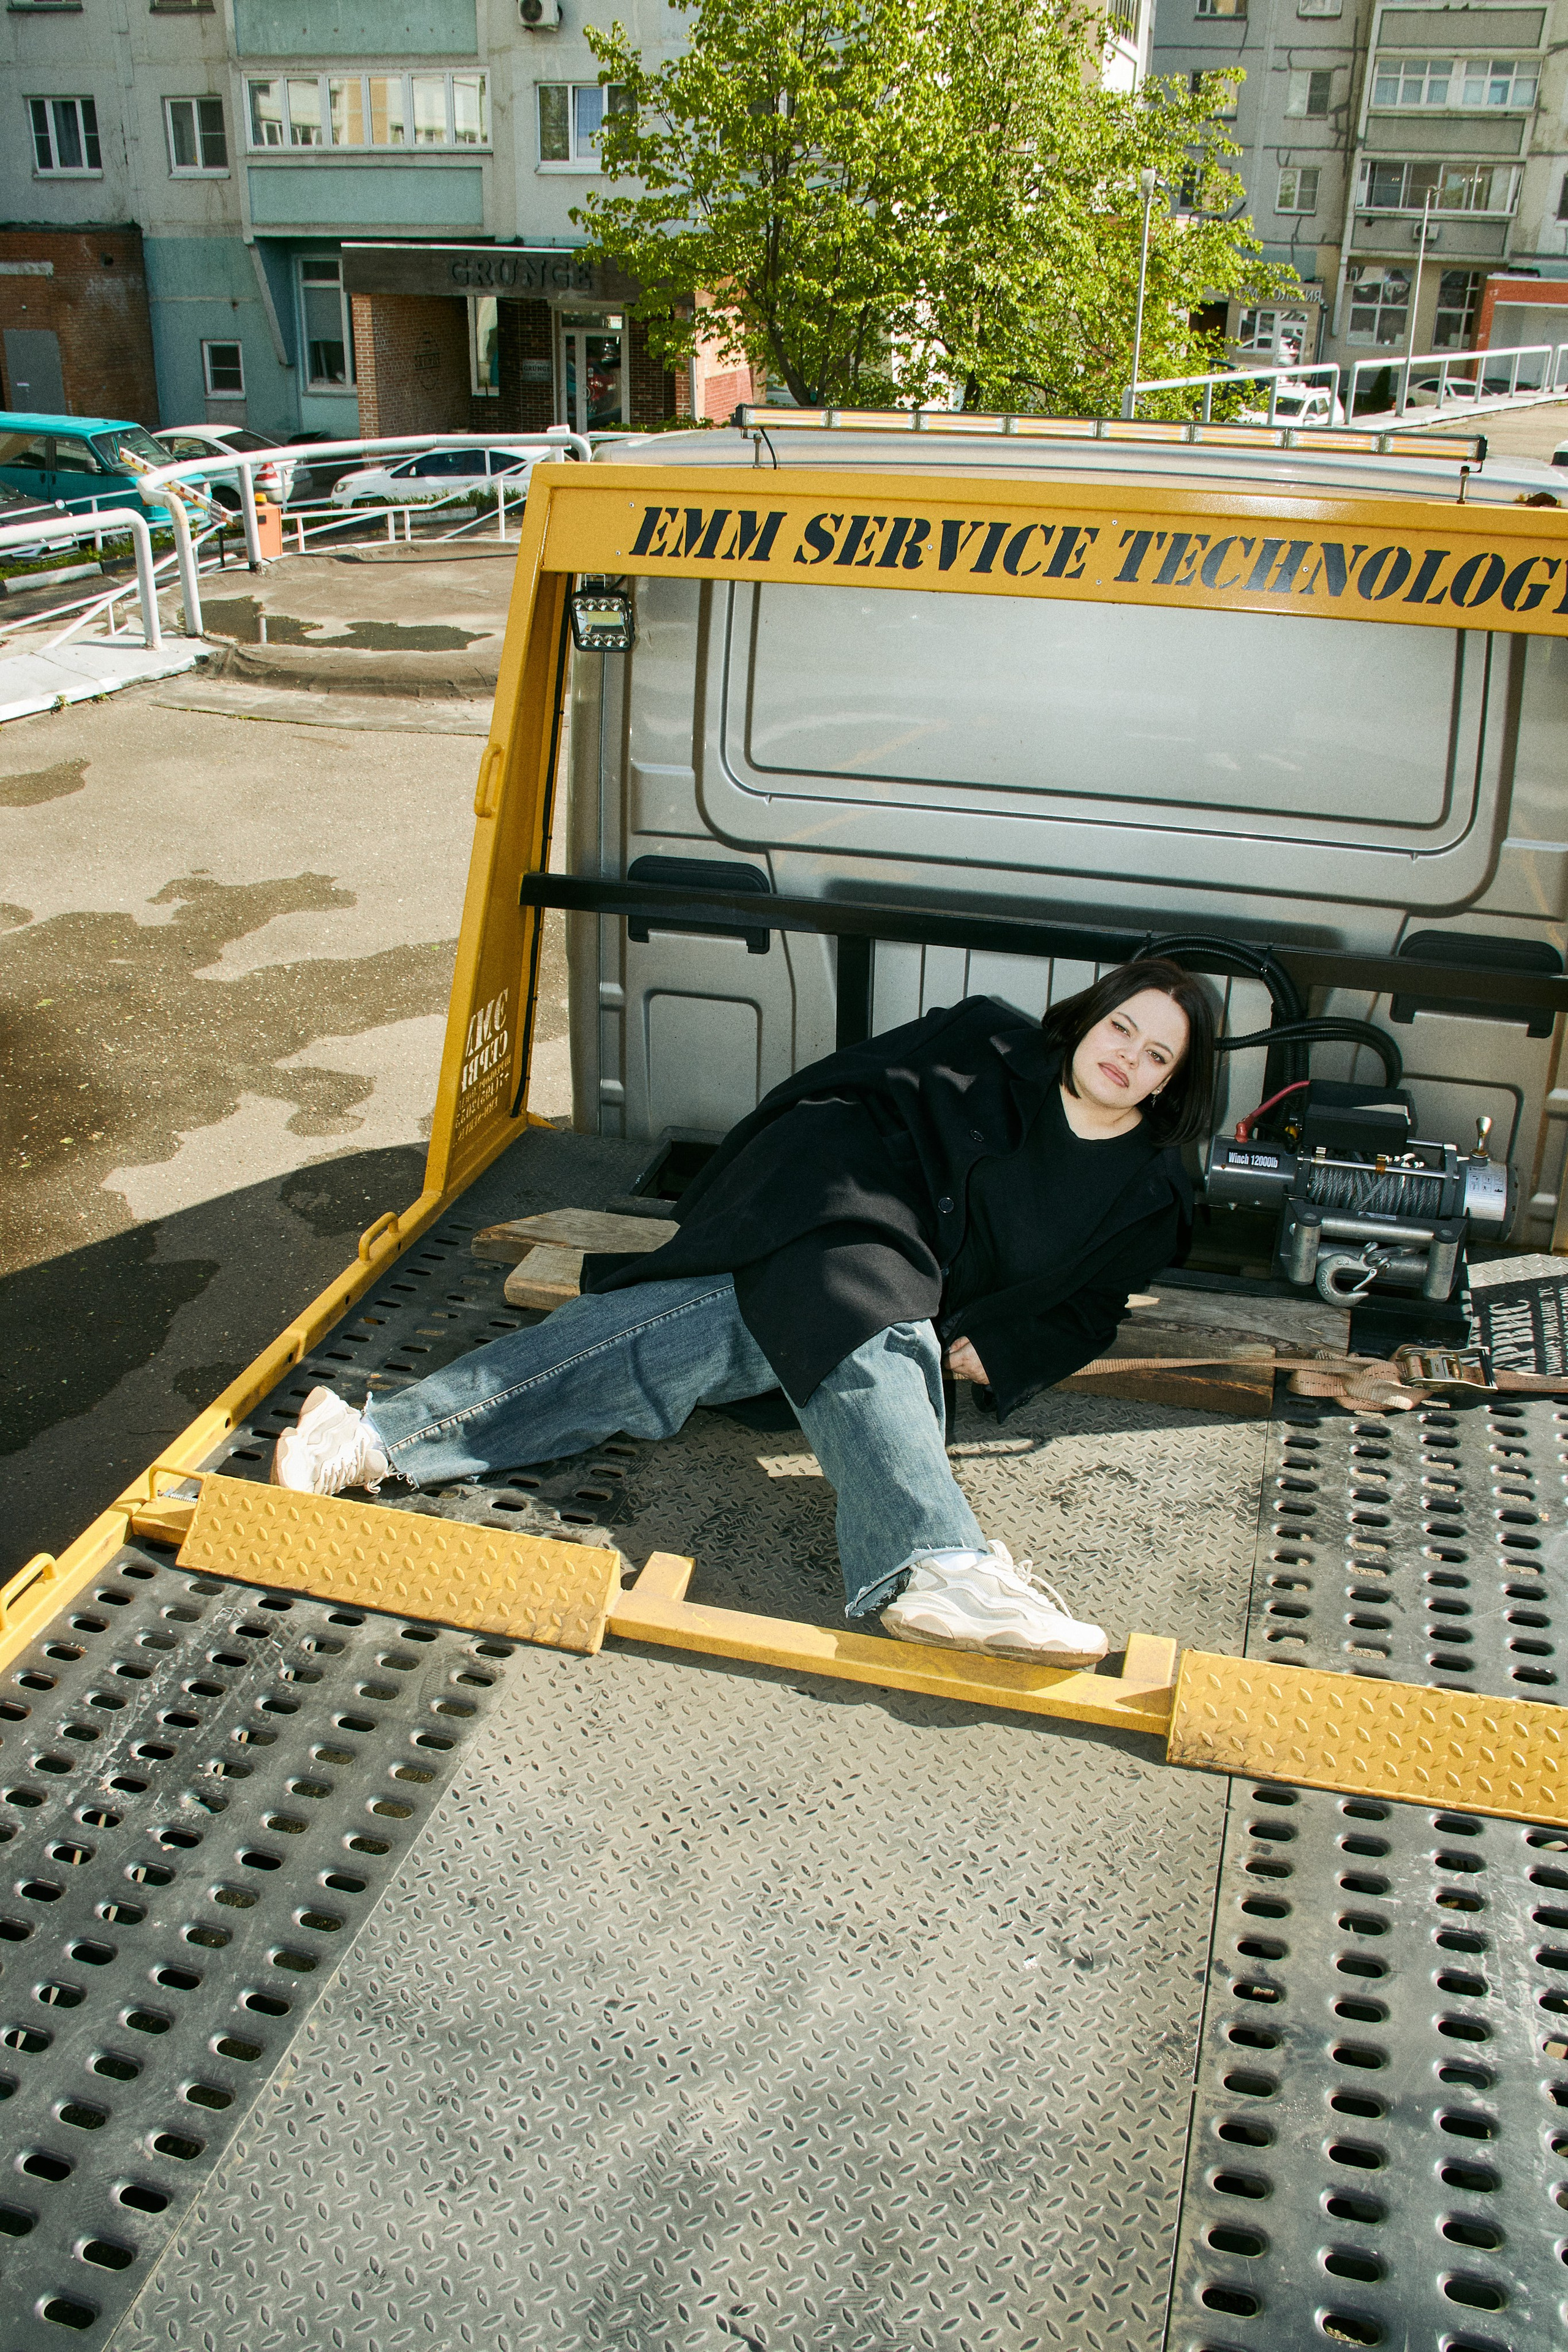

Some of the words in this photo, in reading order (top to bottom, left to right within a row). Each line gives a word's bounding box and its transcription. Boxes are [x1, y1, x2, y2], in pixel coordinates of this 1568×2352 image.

[450, 258, 592, 290] GRUNGE
[628, 507, 788, 561] EMM
[793, 513, 1101, 579] SERVICE
[1229, 1152, 1249, 1165] Winch
[1251, 1155, 1278, 1169] 12000lb
[1320, 1270, 1330, 1295] FORGED
